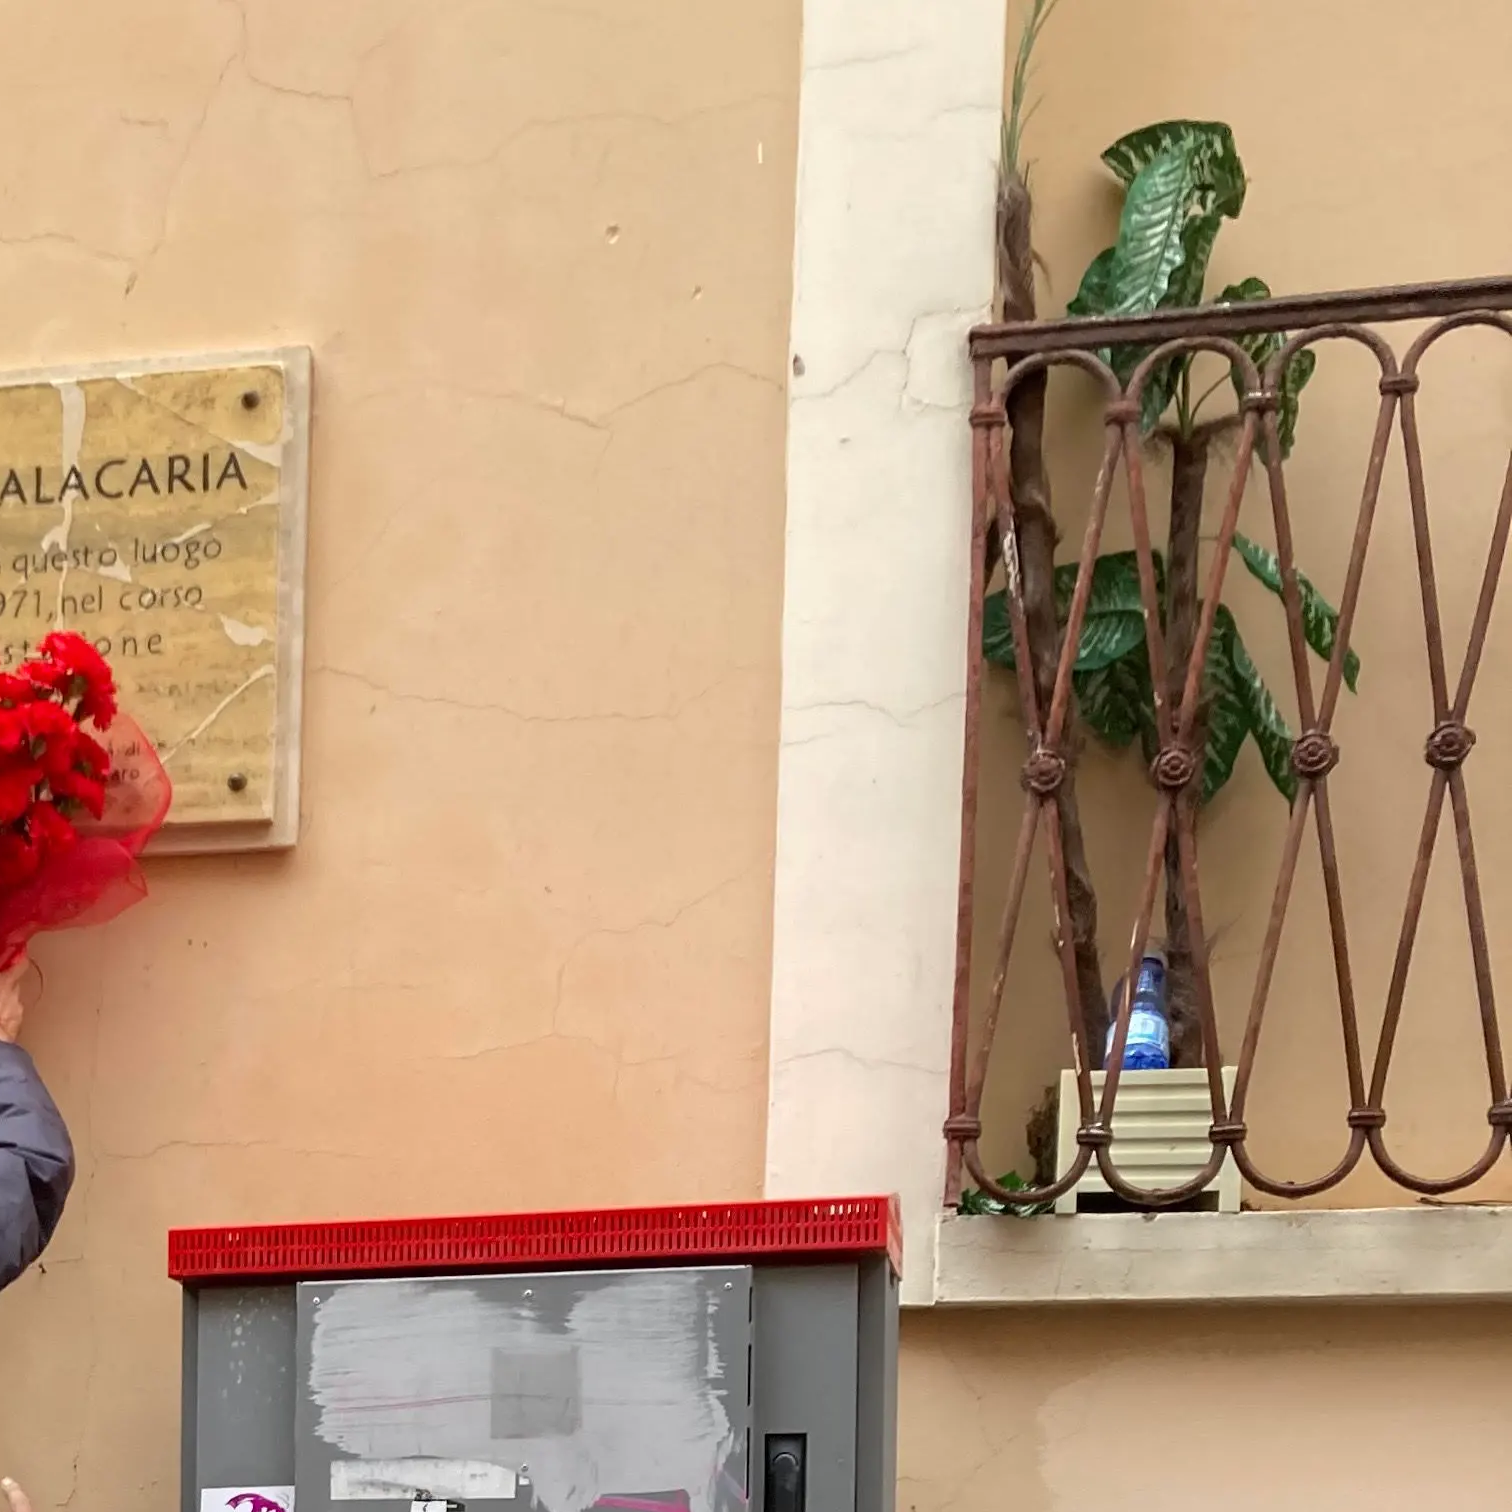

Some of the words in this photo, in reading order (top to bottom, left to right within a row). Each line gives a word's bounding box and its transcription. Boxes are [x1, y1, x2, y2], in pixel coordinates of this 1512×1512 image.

[11, 545, 118, 581] questo
[133, 537, 223, 570] luogo
[60, 585, 104, 617] nel
[118, 585, 203, 612] corso
